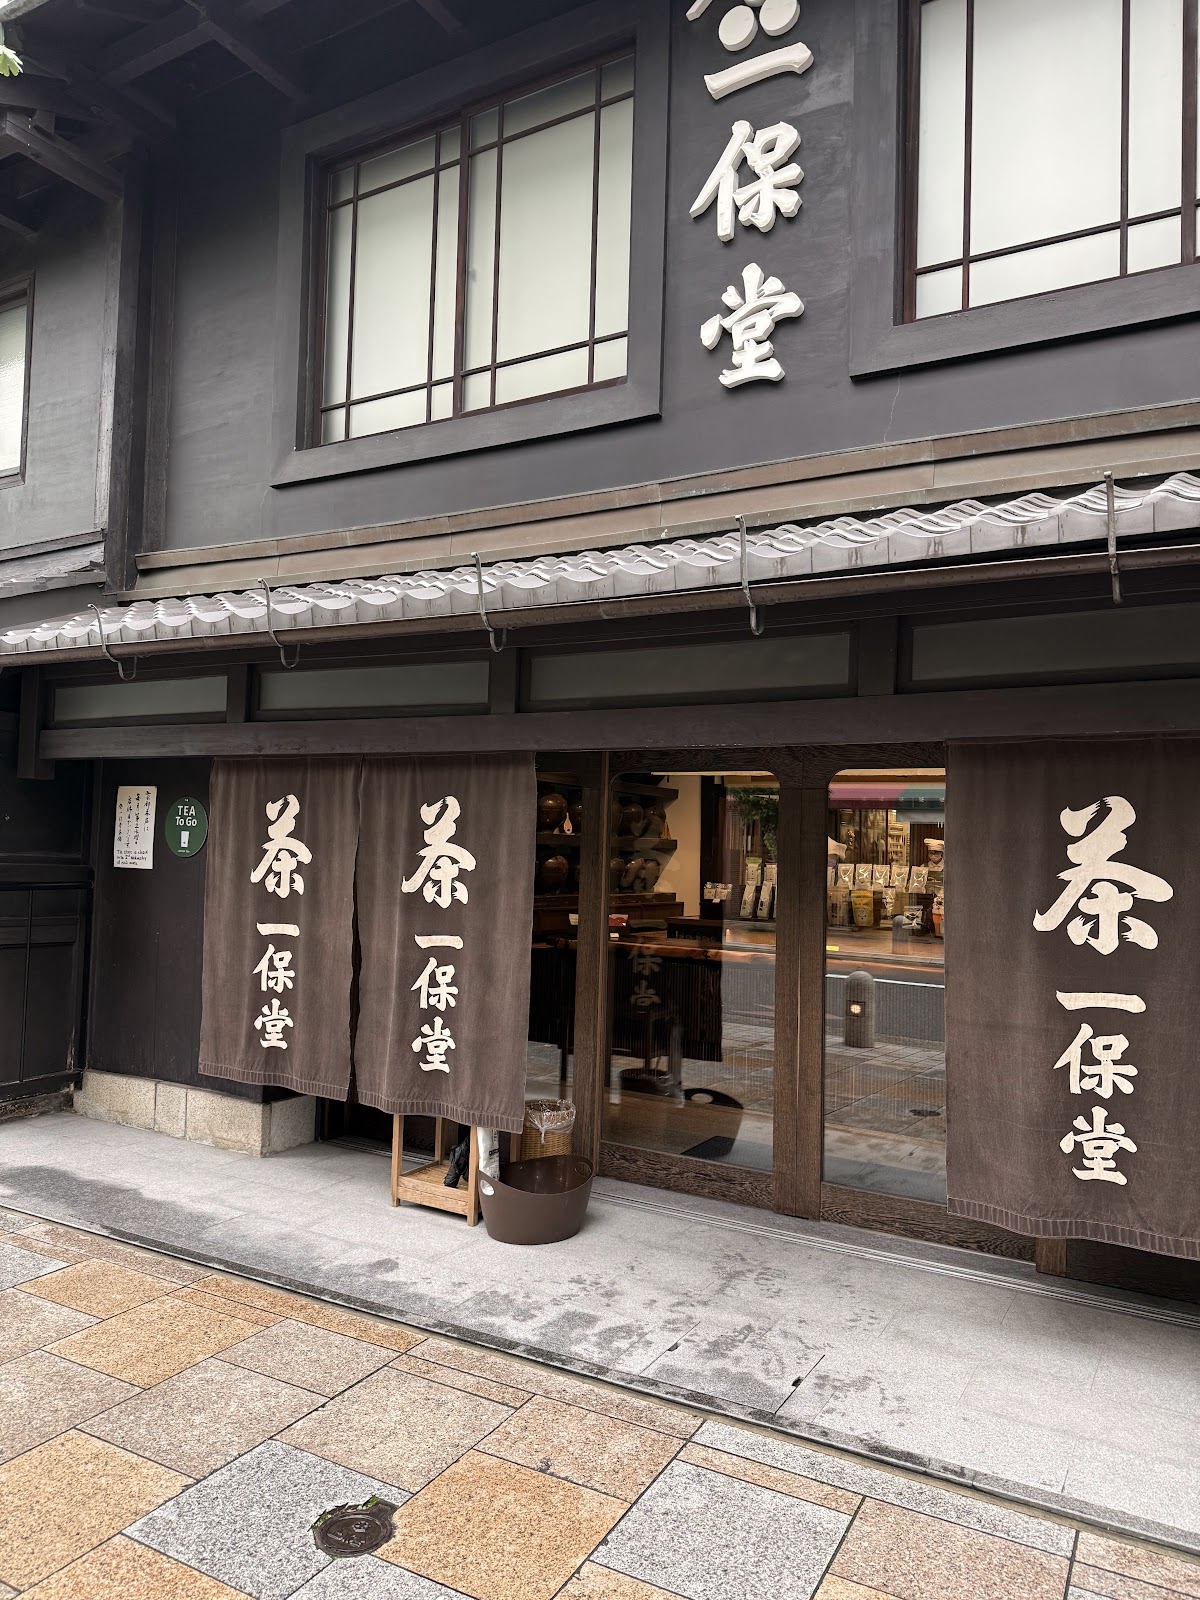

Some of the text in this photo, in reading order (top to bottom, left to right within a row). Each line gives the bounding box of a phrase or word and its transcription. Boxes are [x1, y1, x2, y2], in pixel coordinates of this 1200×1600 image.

[689, 42, 814, 388] 一保堂
[175, 816, 198, 827] To Go
[178, 805, 196, 816] TEA
[250, 795, 312, 1050] 茶一保堂
[401, 796, 477, 1075] 茶一保堂
[1033, 796, 1173, 1186] 茶一保堂
